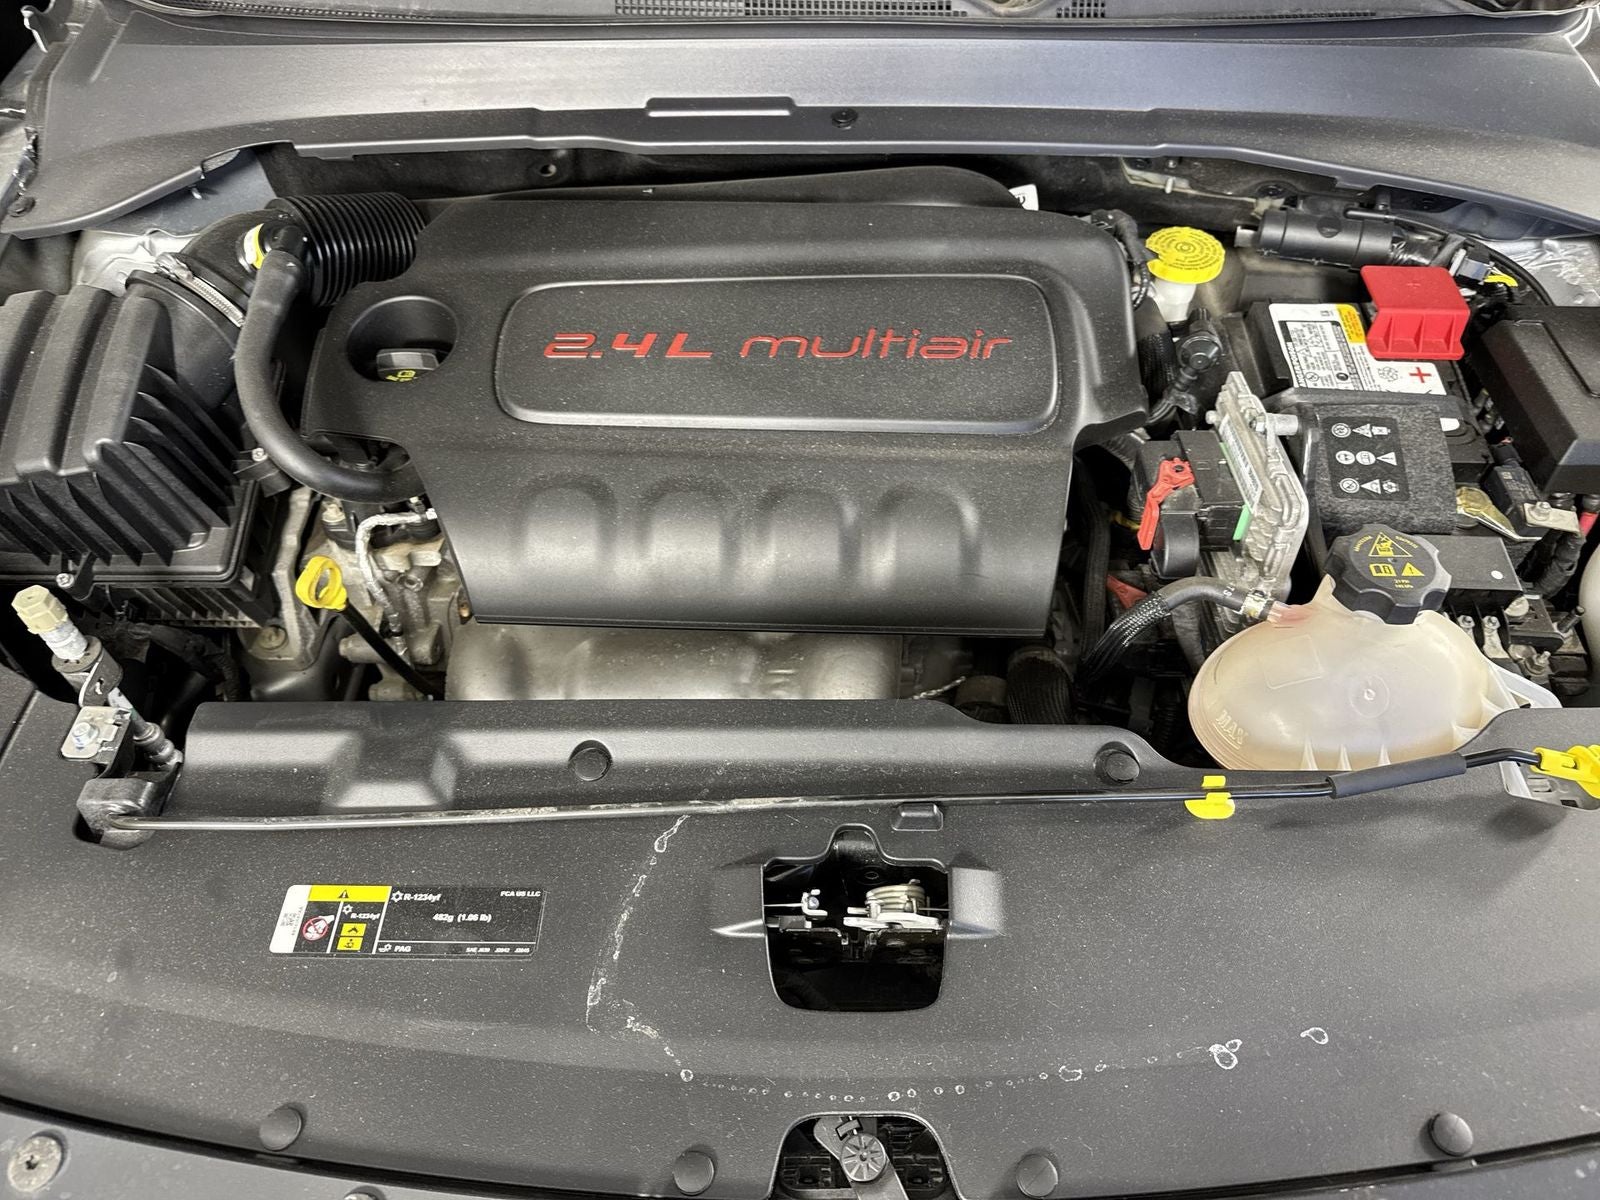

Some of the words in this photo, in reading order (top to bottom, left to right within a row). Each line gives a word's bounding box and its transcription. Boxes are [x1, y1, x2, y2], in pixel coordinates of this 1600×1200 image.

[739, 327, 1013, 360] multiair
[403, 893, 442, 903] R-1234yf
[394, 945, 412, 953] PAG
